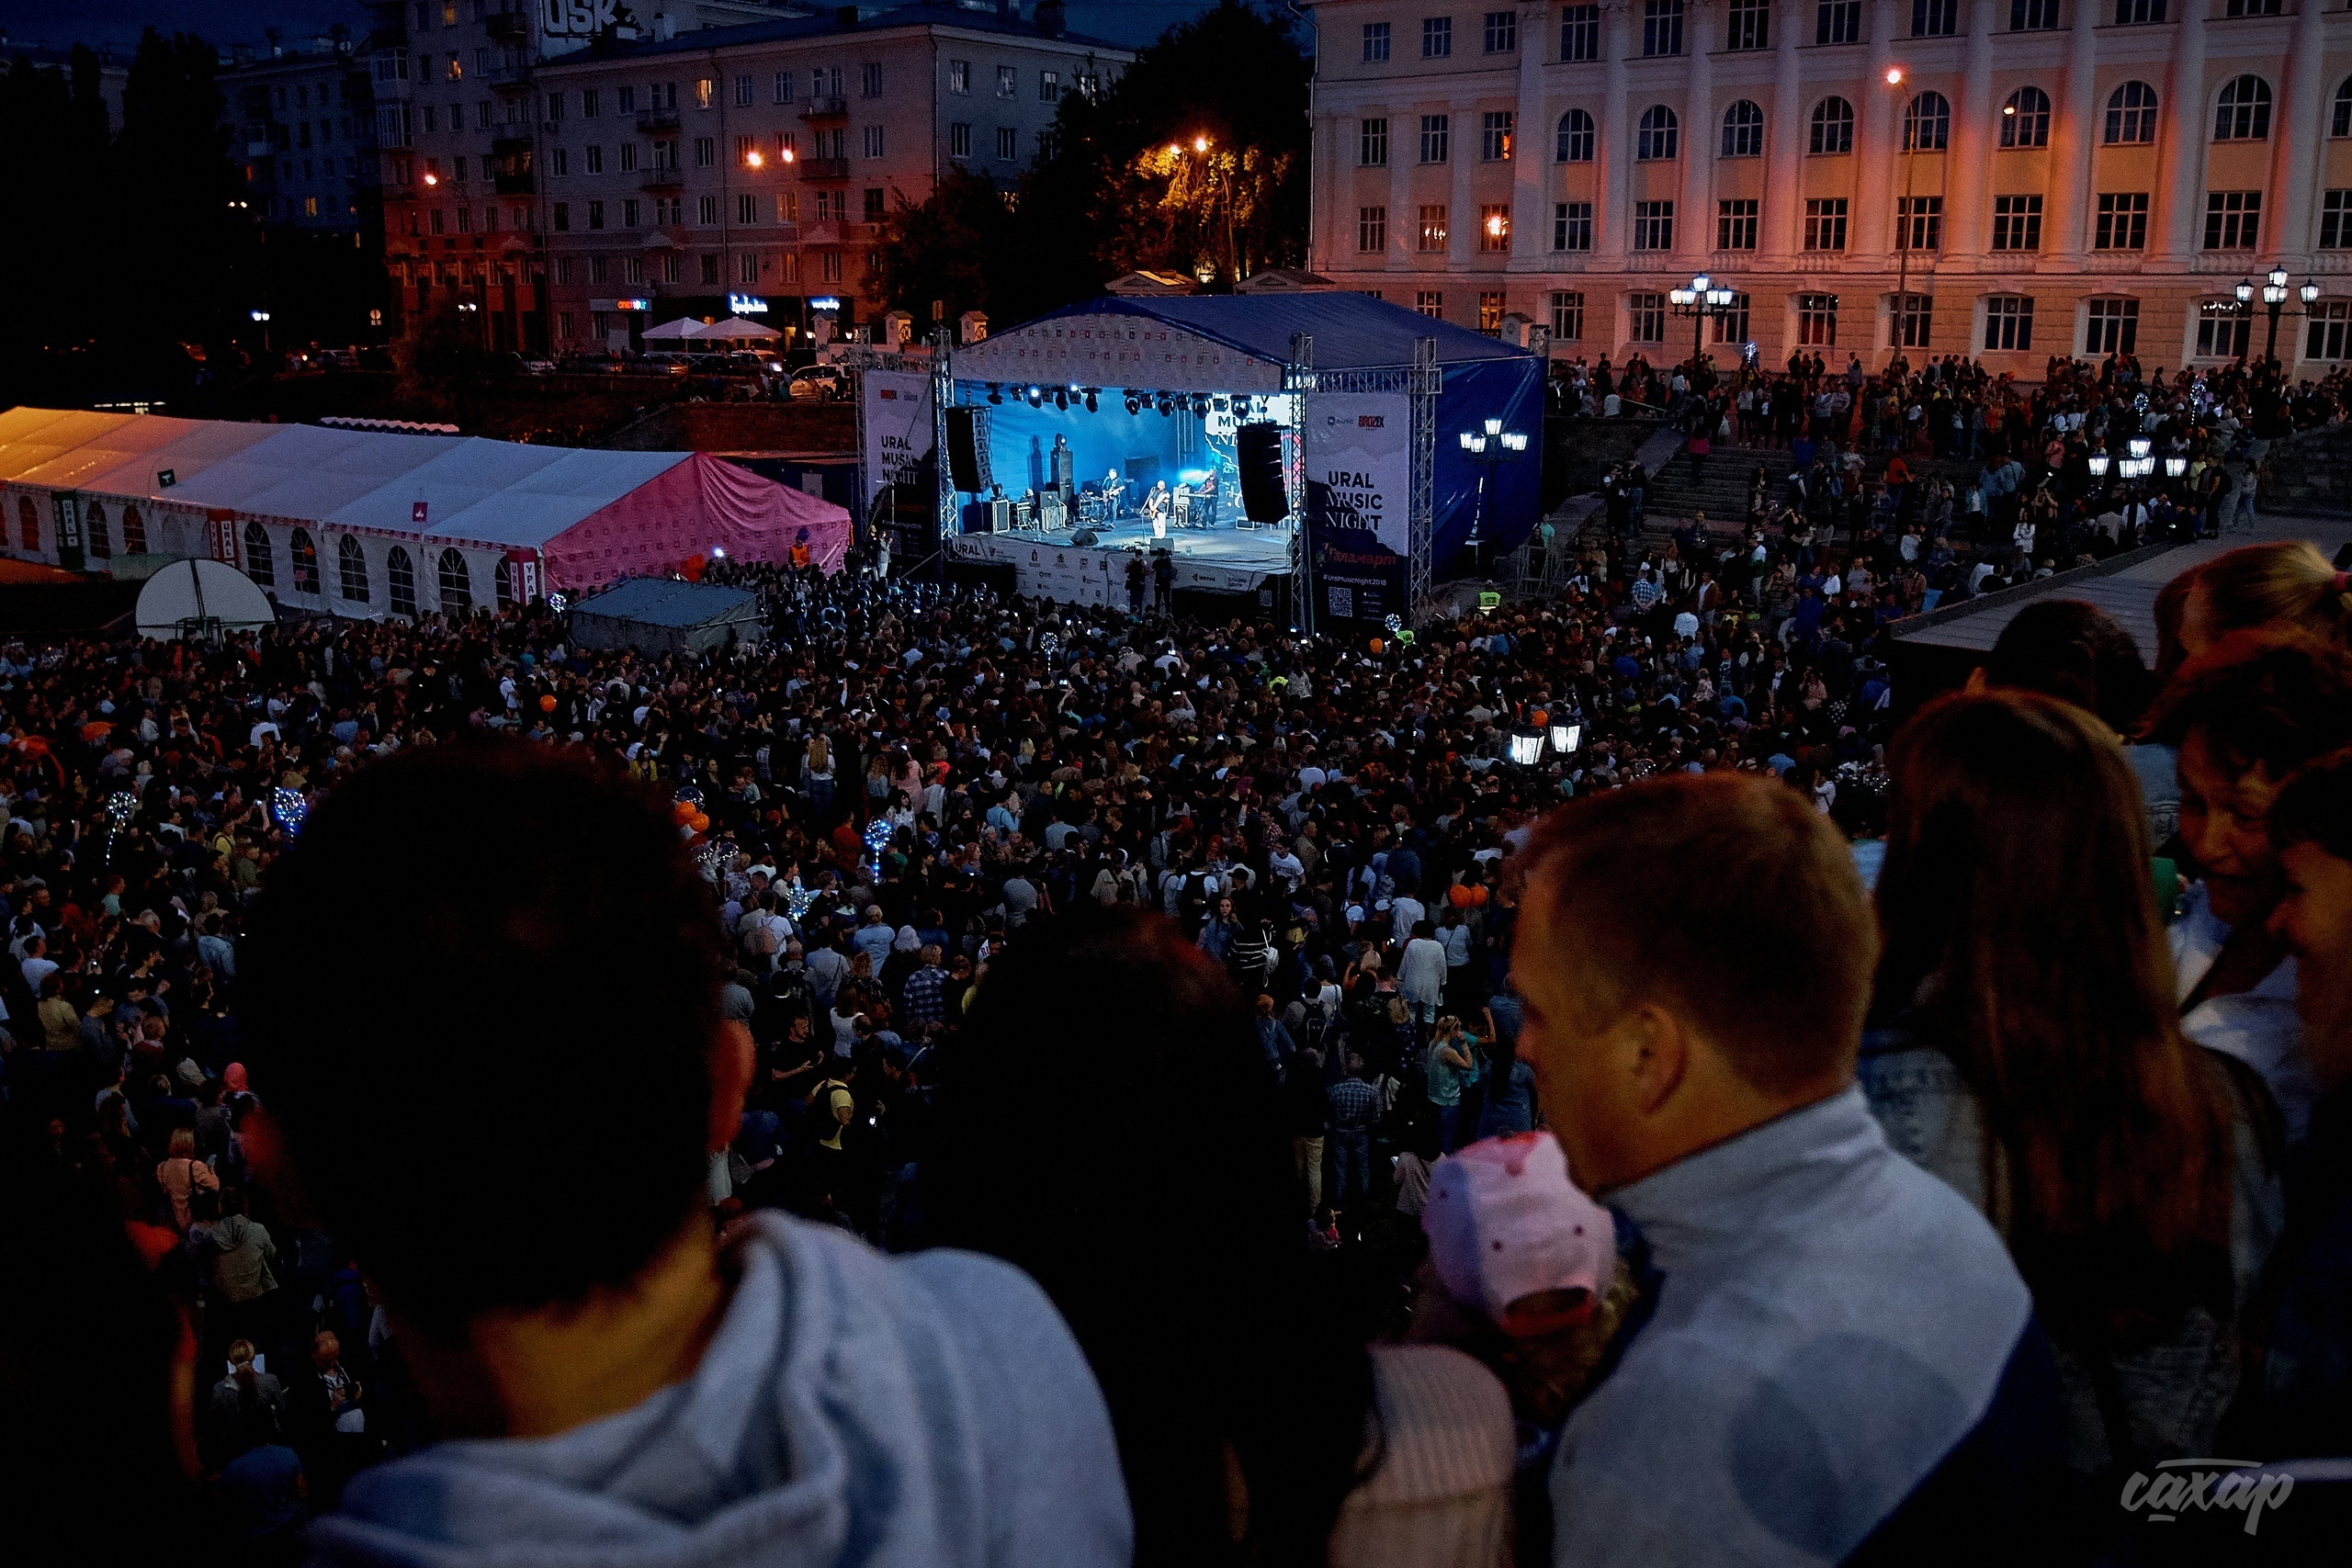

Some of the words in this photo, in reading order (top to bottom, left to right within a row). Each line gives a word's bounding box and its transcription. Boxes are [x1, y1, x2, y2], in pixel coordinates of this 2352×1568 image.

[881, 434, 911, 450] URAL
[882, 452, 920, 468] MUSIC
[882, 468, 918, 485] NIGHT
[1329, 470, 1374, 489] URAL
[1325, 491, 1383, 510] MUSIC
[1325, 511, 1383, 531] NIGHT
[955, 543, 980, 556] URAL
